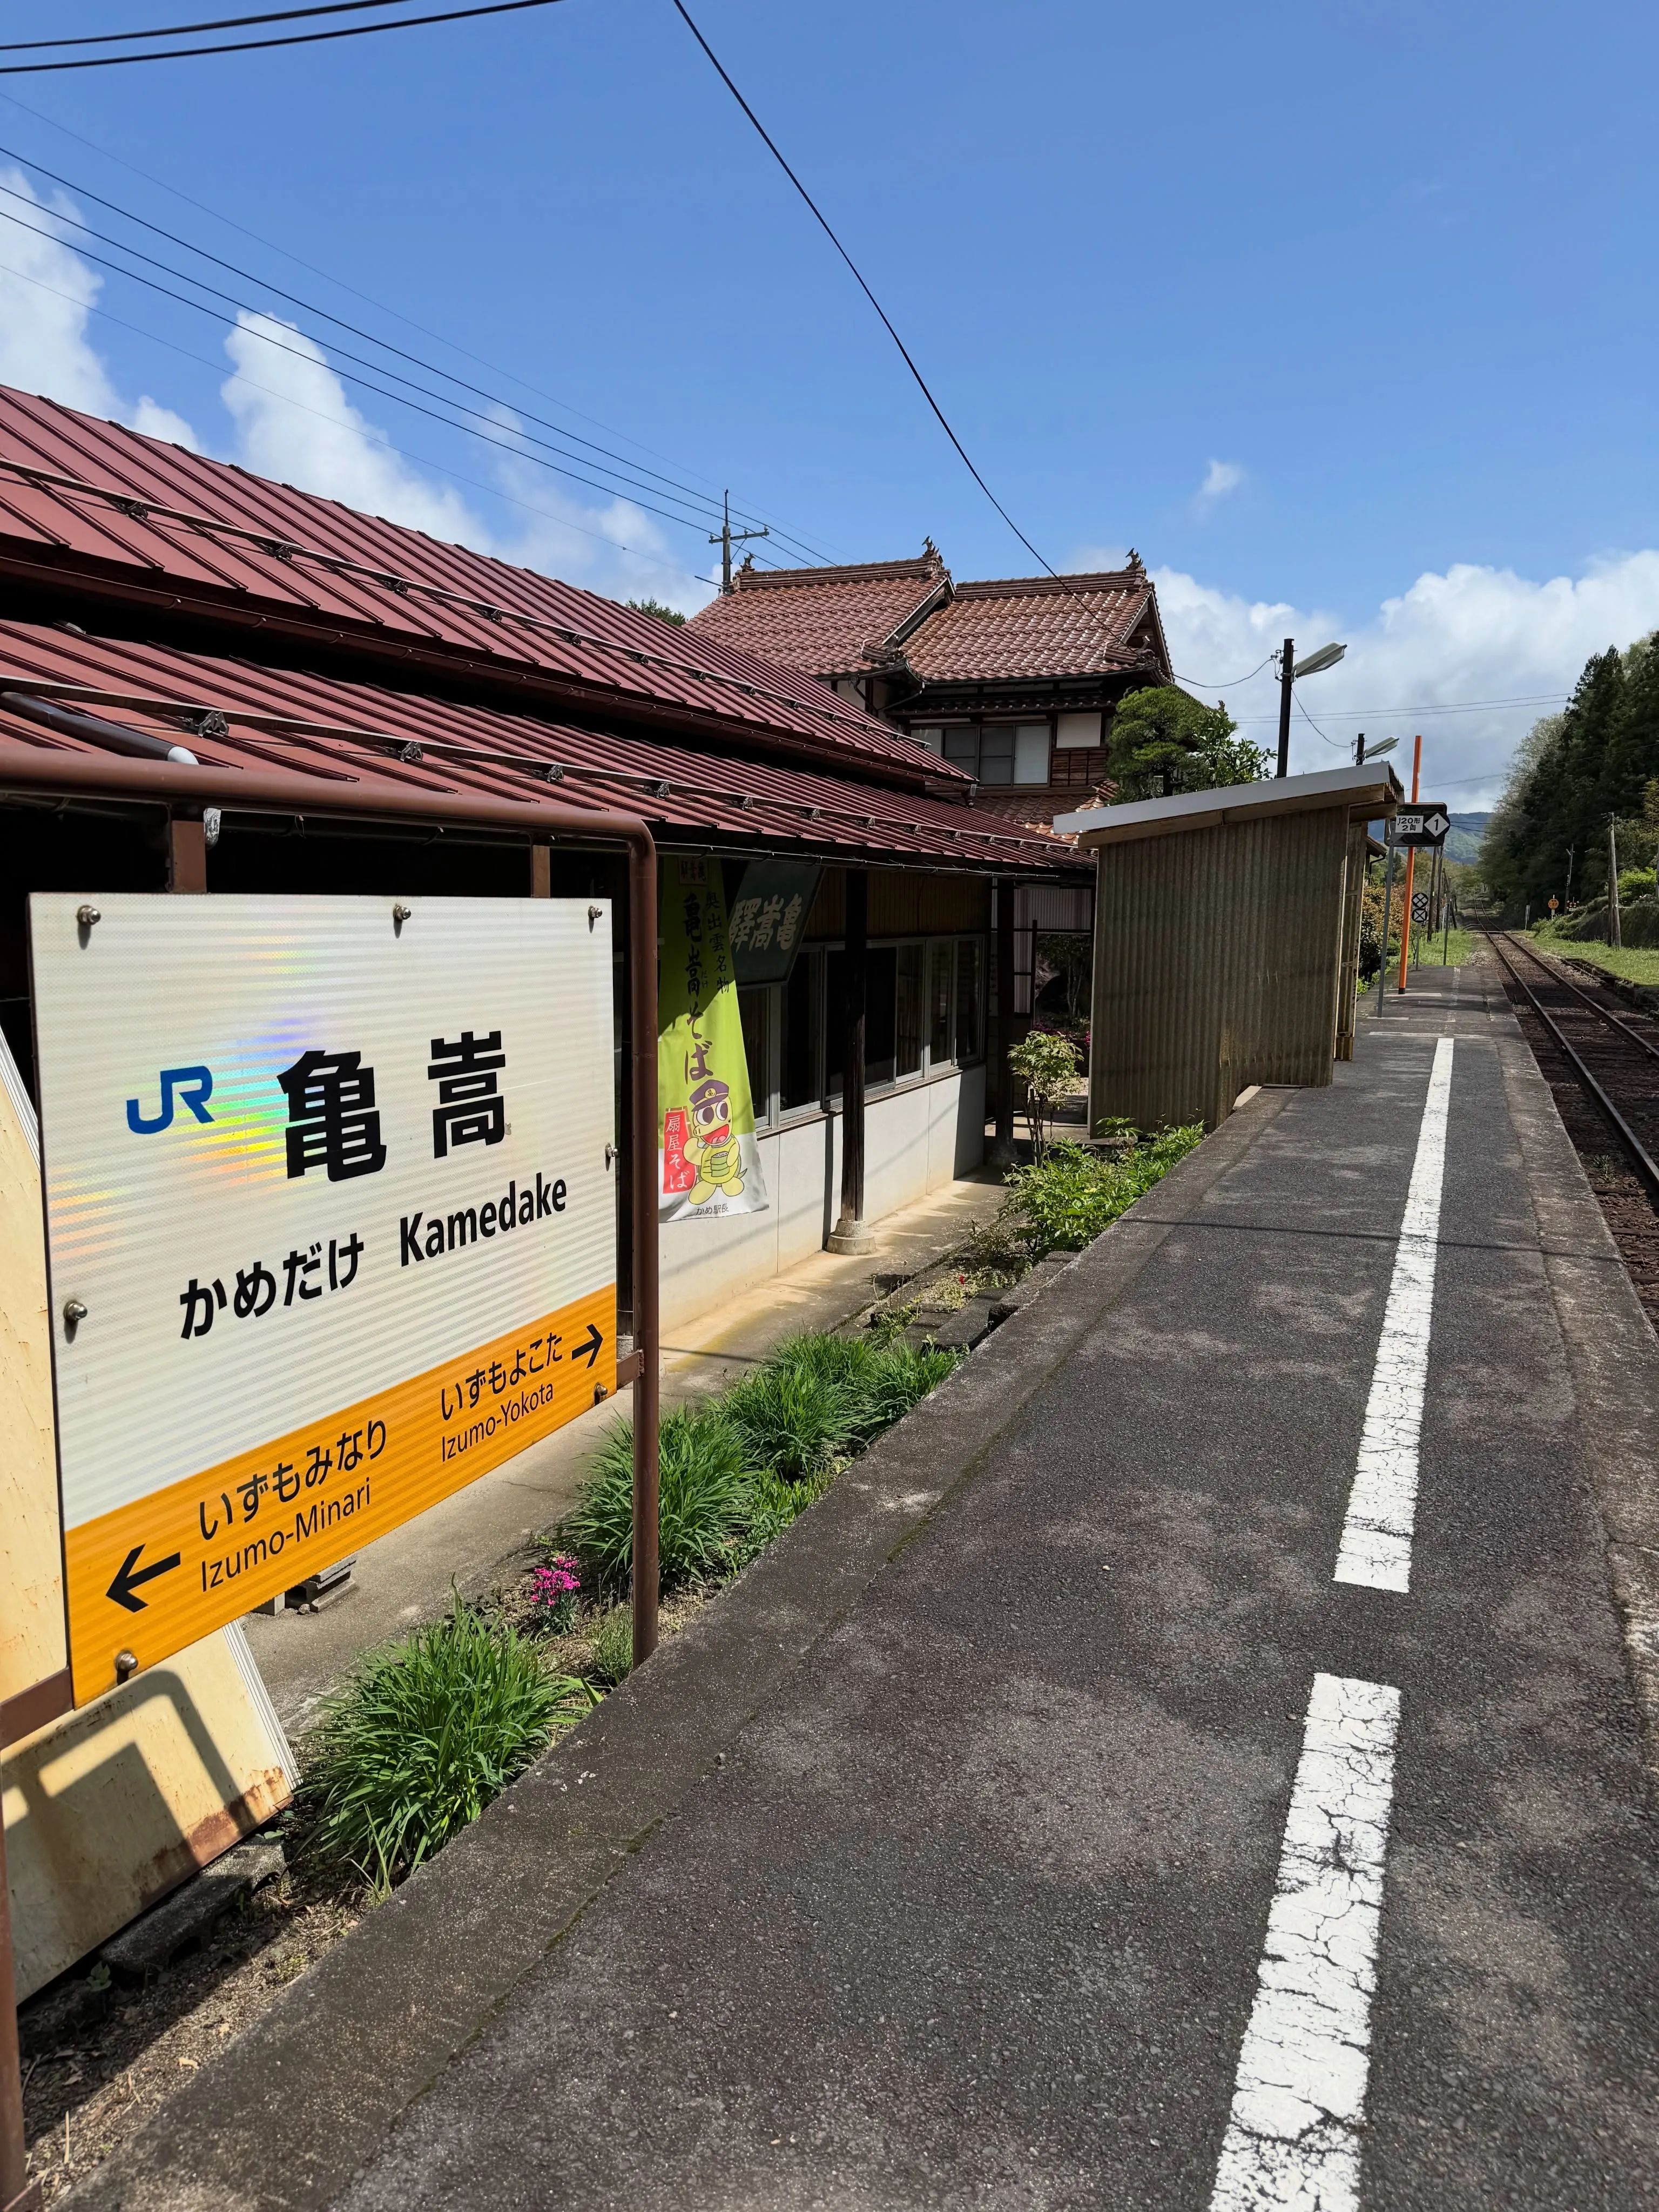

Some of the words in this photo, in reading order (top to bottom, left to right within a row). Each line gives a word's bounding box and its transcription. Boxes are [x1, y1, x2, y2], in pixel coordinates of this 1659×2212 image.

[1434, 818, 1439, 831] 1
[705, 891, 730, 994] 奥出雲名物
[126, 1065, 215, 1135] JR
[276, 1030, 506, 1183] 亀嵩
[665, 1115, 690, 1190] 扇屋そば
[179, 1232, 365, 1340] かめだけ
[400, 1172, 567, 1267] Kamedake
[696, 1203, 729, 1216] かめ駅長
[441, 1332, 563, 1421] いずもよこた
[442, 1382, 554, 1462] Izumo-Yokota
[199, 1419, 387, 1541] いずもみなり
[201, 1477, 371, 1593] Izumo-Minari
